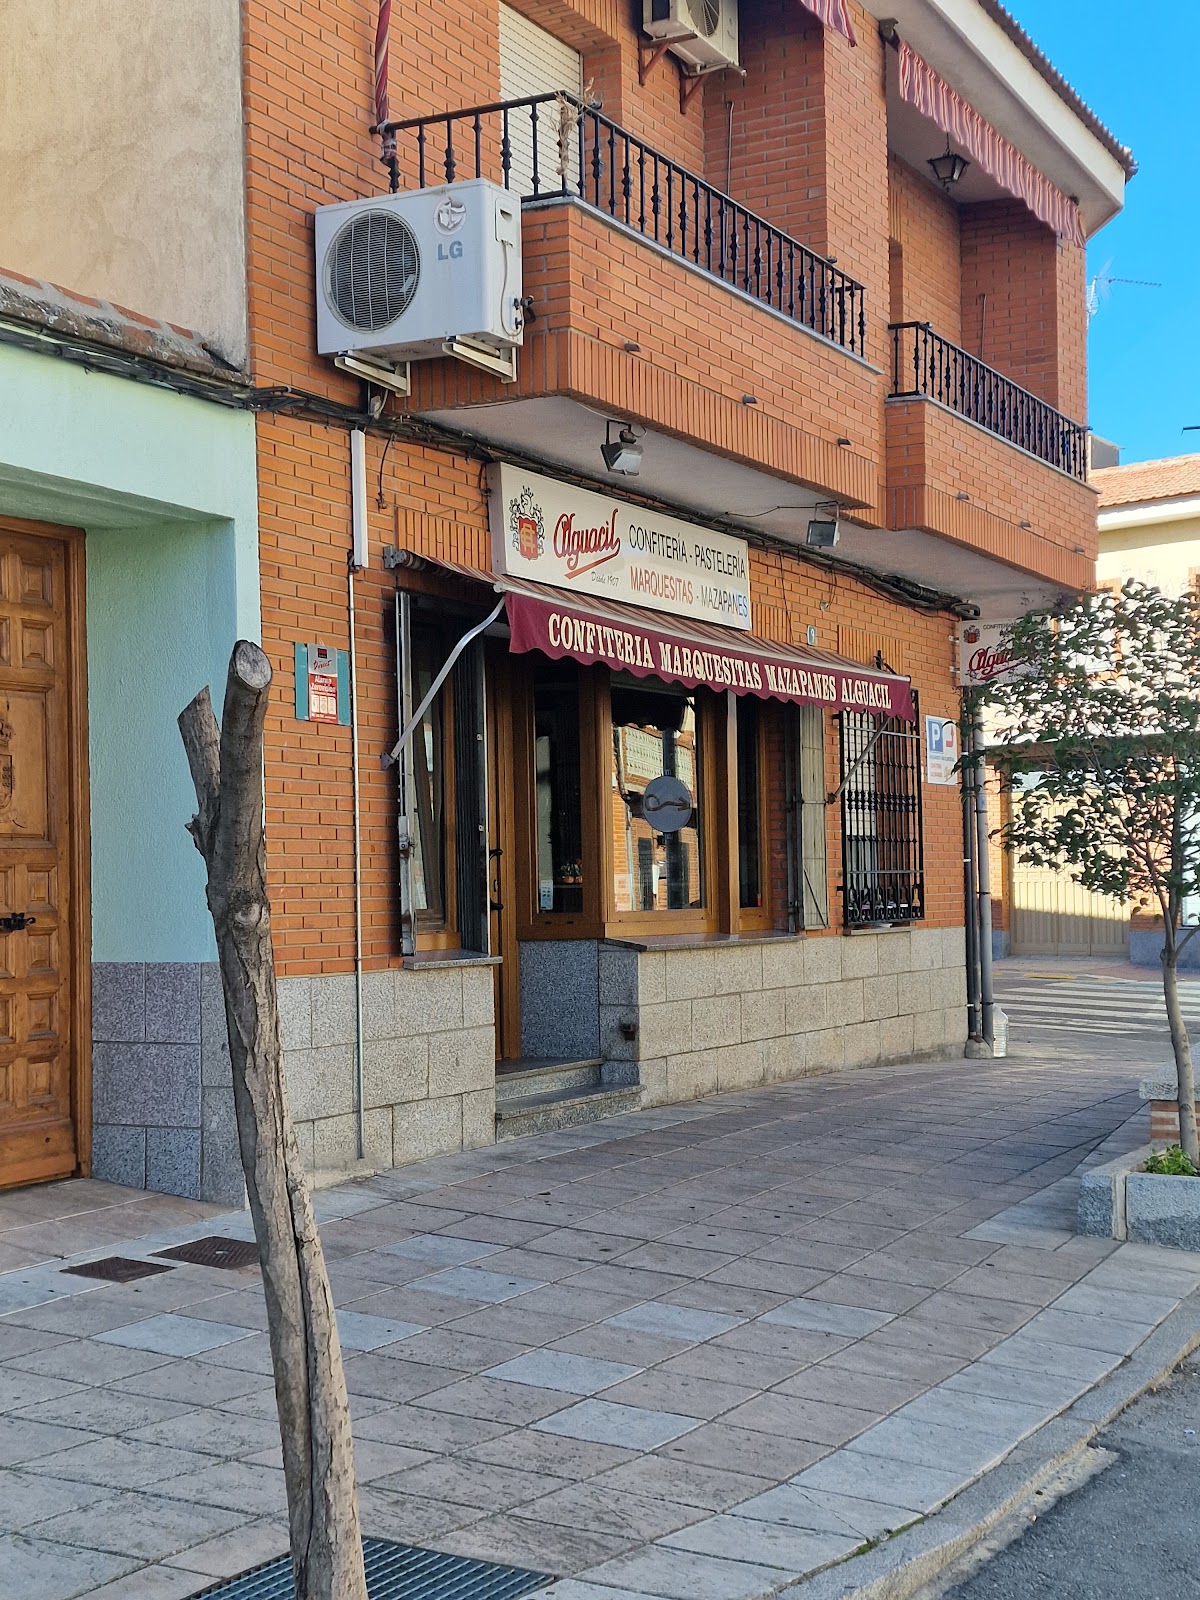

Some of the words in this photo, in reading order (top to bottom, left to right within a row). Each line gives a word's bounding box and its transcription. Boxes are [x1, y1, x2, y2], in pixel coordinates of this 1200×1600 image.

[438, 241, 463, 260] LG
[553, 508, 620, 572] Alguacil
[629, 524, 688, 563] CONFITERÍA
[694, 544, 747, 580] PASTELERÍA
[591, 571, 606, 584] Desde
[607, 575, 620, 587] 1907
[630, 565, 694, 605] MARQUESITAS
[701, 585, 748, 618] MAZAPANES
[548, 613, 656, 669] CONFITERIA
[658, 641, 763, 691] MARQUESITAS
[764, 664, 837, 702] MAZAPANES
[841, 677, 892, 709] ALGUACIL
[931, 722, 941, 750] P
